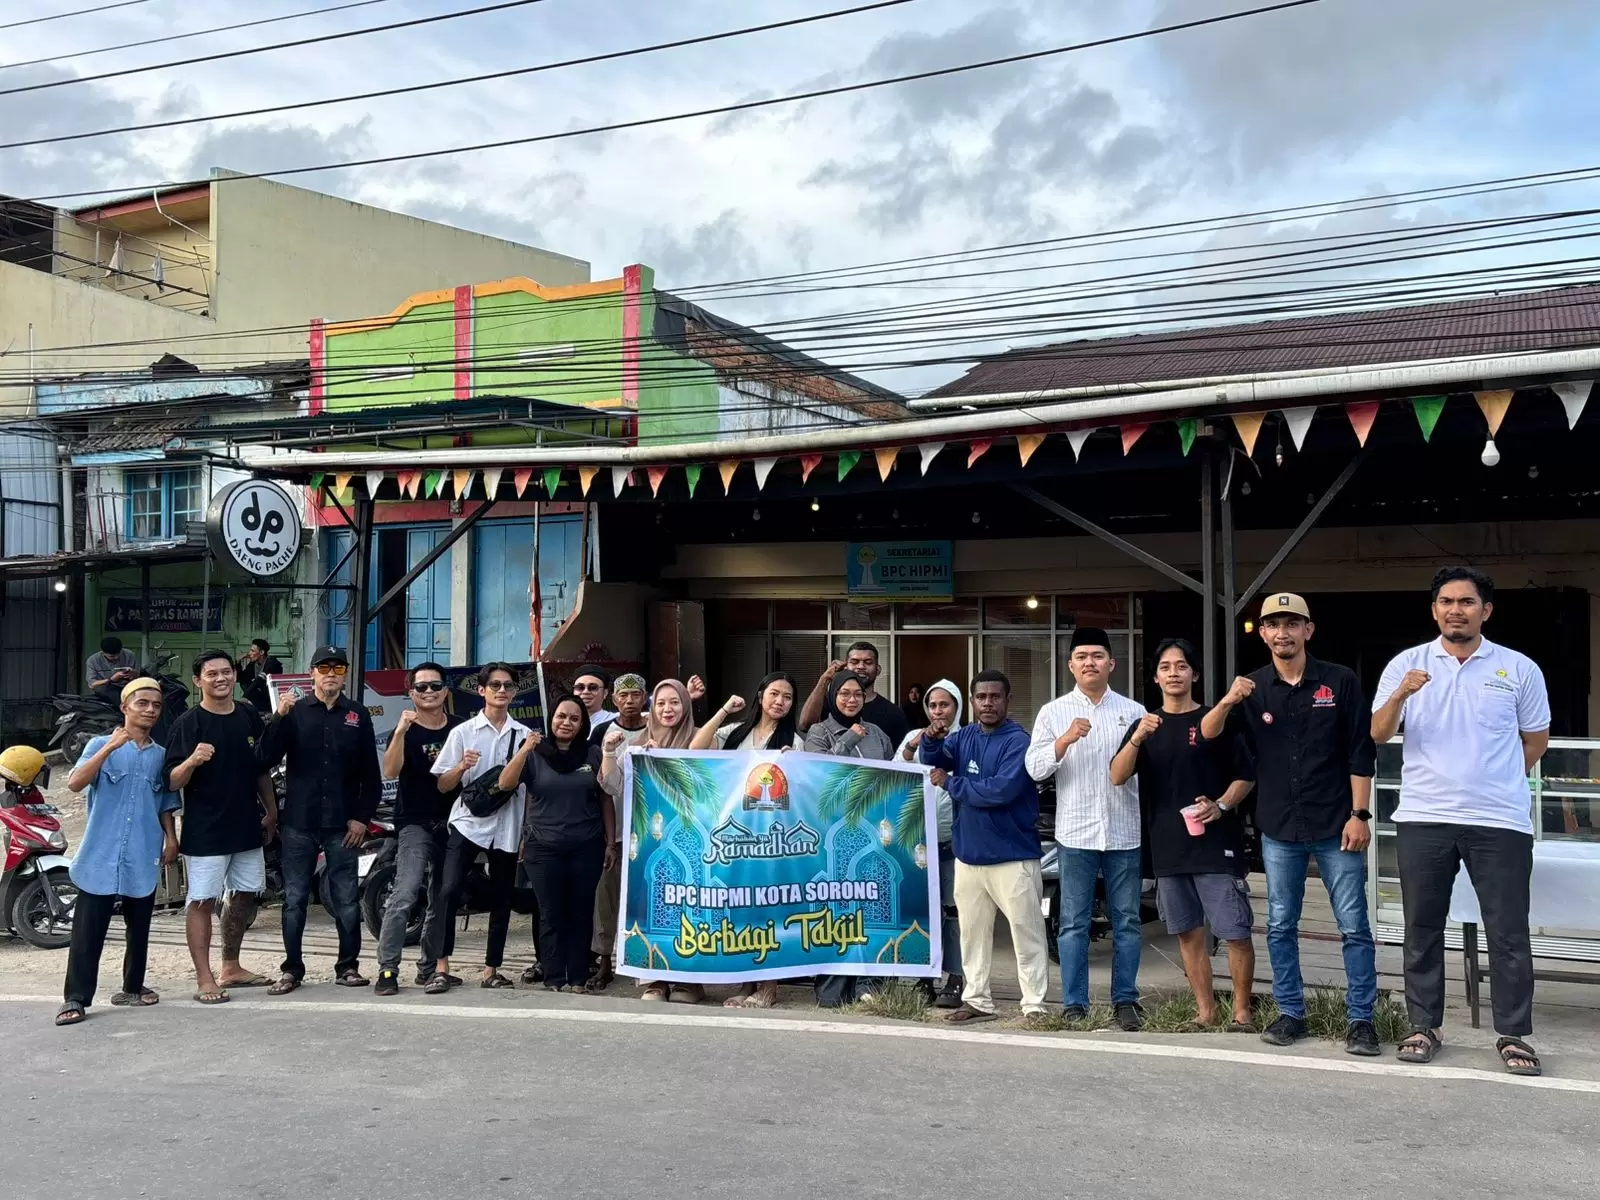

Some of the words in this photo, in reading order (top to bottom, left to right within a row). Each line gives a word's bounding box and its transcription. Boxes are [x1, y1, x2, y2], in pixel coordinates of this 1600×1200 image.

[241, 491, 284, 543] dp
[229, 538, 262, 571] DAENG
[265, 546, 294, 572] PACHE
[887, 547, 941, 556] SEKRETARIAT
[881, 565, 906, 577] BPC
[909, 564, 948, 577] HIPMI
[702, 824, 818, 865] Ramadhan
[663, 884, 697, 906] BPC
[699, 886, 751, 908] HIPMI
[754, 884, 802, 906] KOTA
[804, 881, 880, 903] SORONG
[784, 905, 869, 956] Takjil
